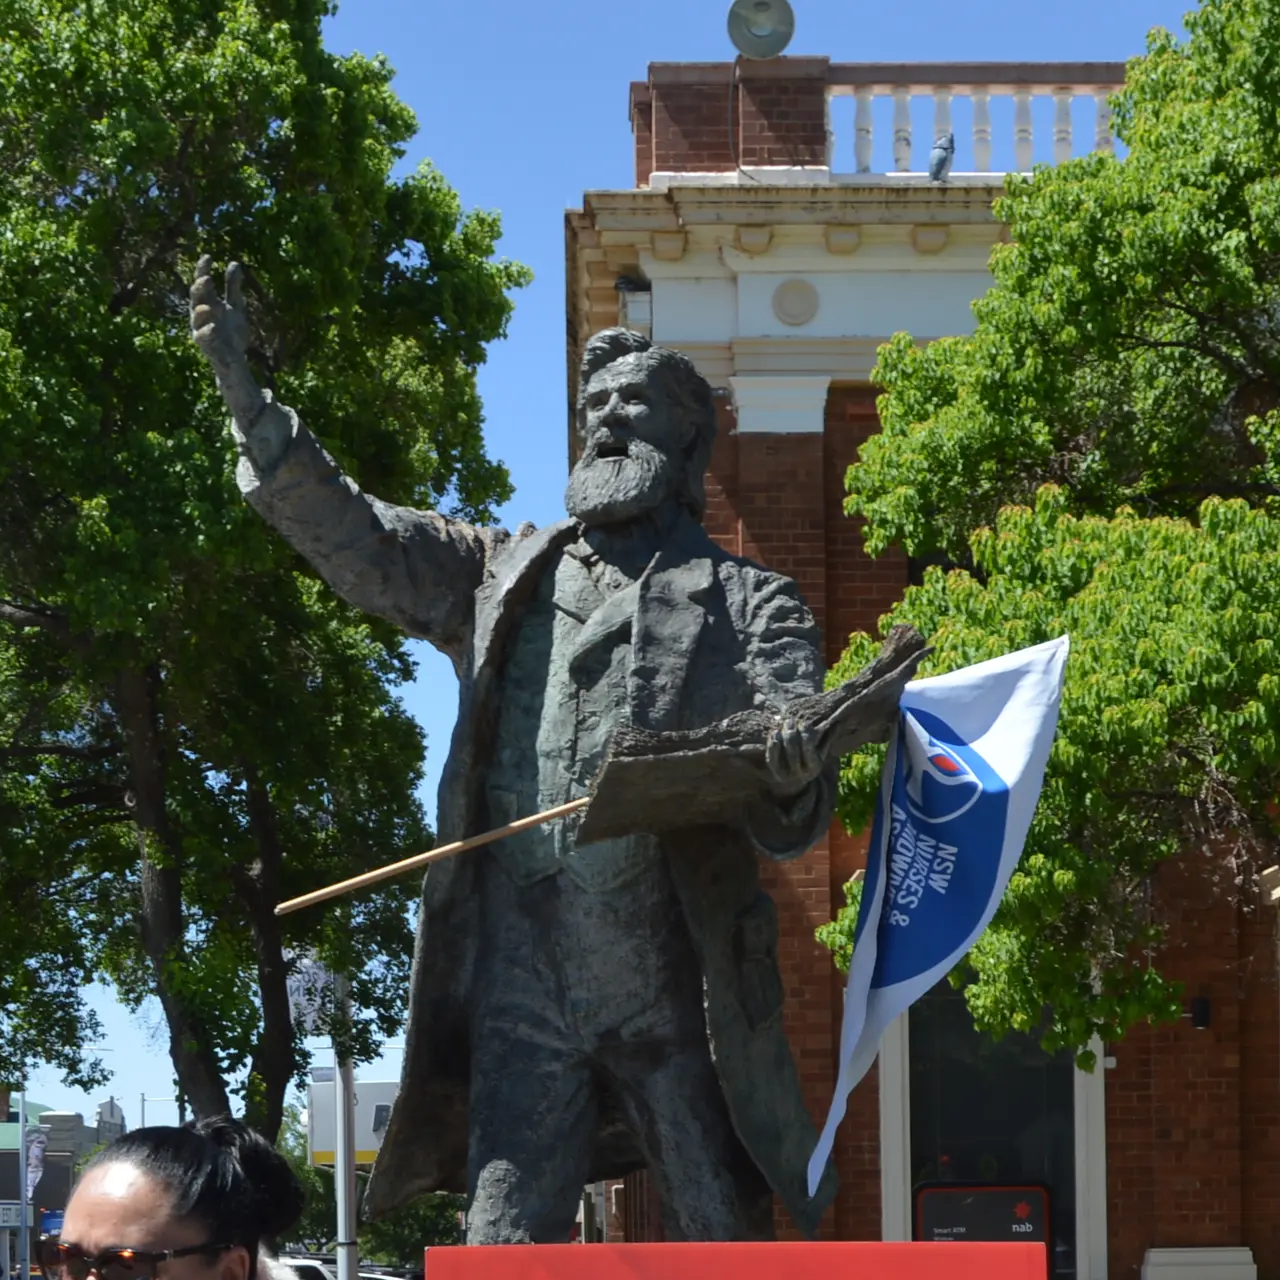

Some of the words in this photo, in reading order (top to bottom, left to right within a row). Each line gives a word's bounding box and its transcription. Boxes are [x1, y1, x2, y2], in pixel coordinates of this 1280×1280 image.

[896, 833, 937, 910] NURSES
[927, 842, 959, 895] NSW
[889, 909, 910, 927] &
[1012, 1222, 1033, 1232] nab
